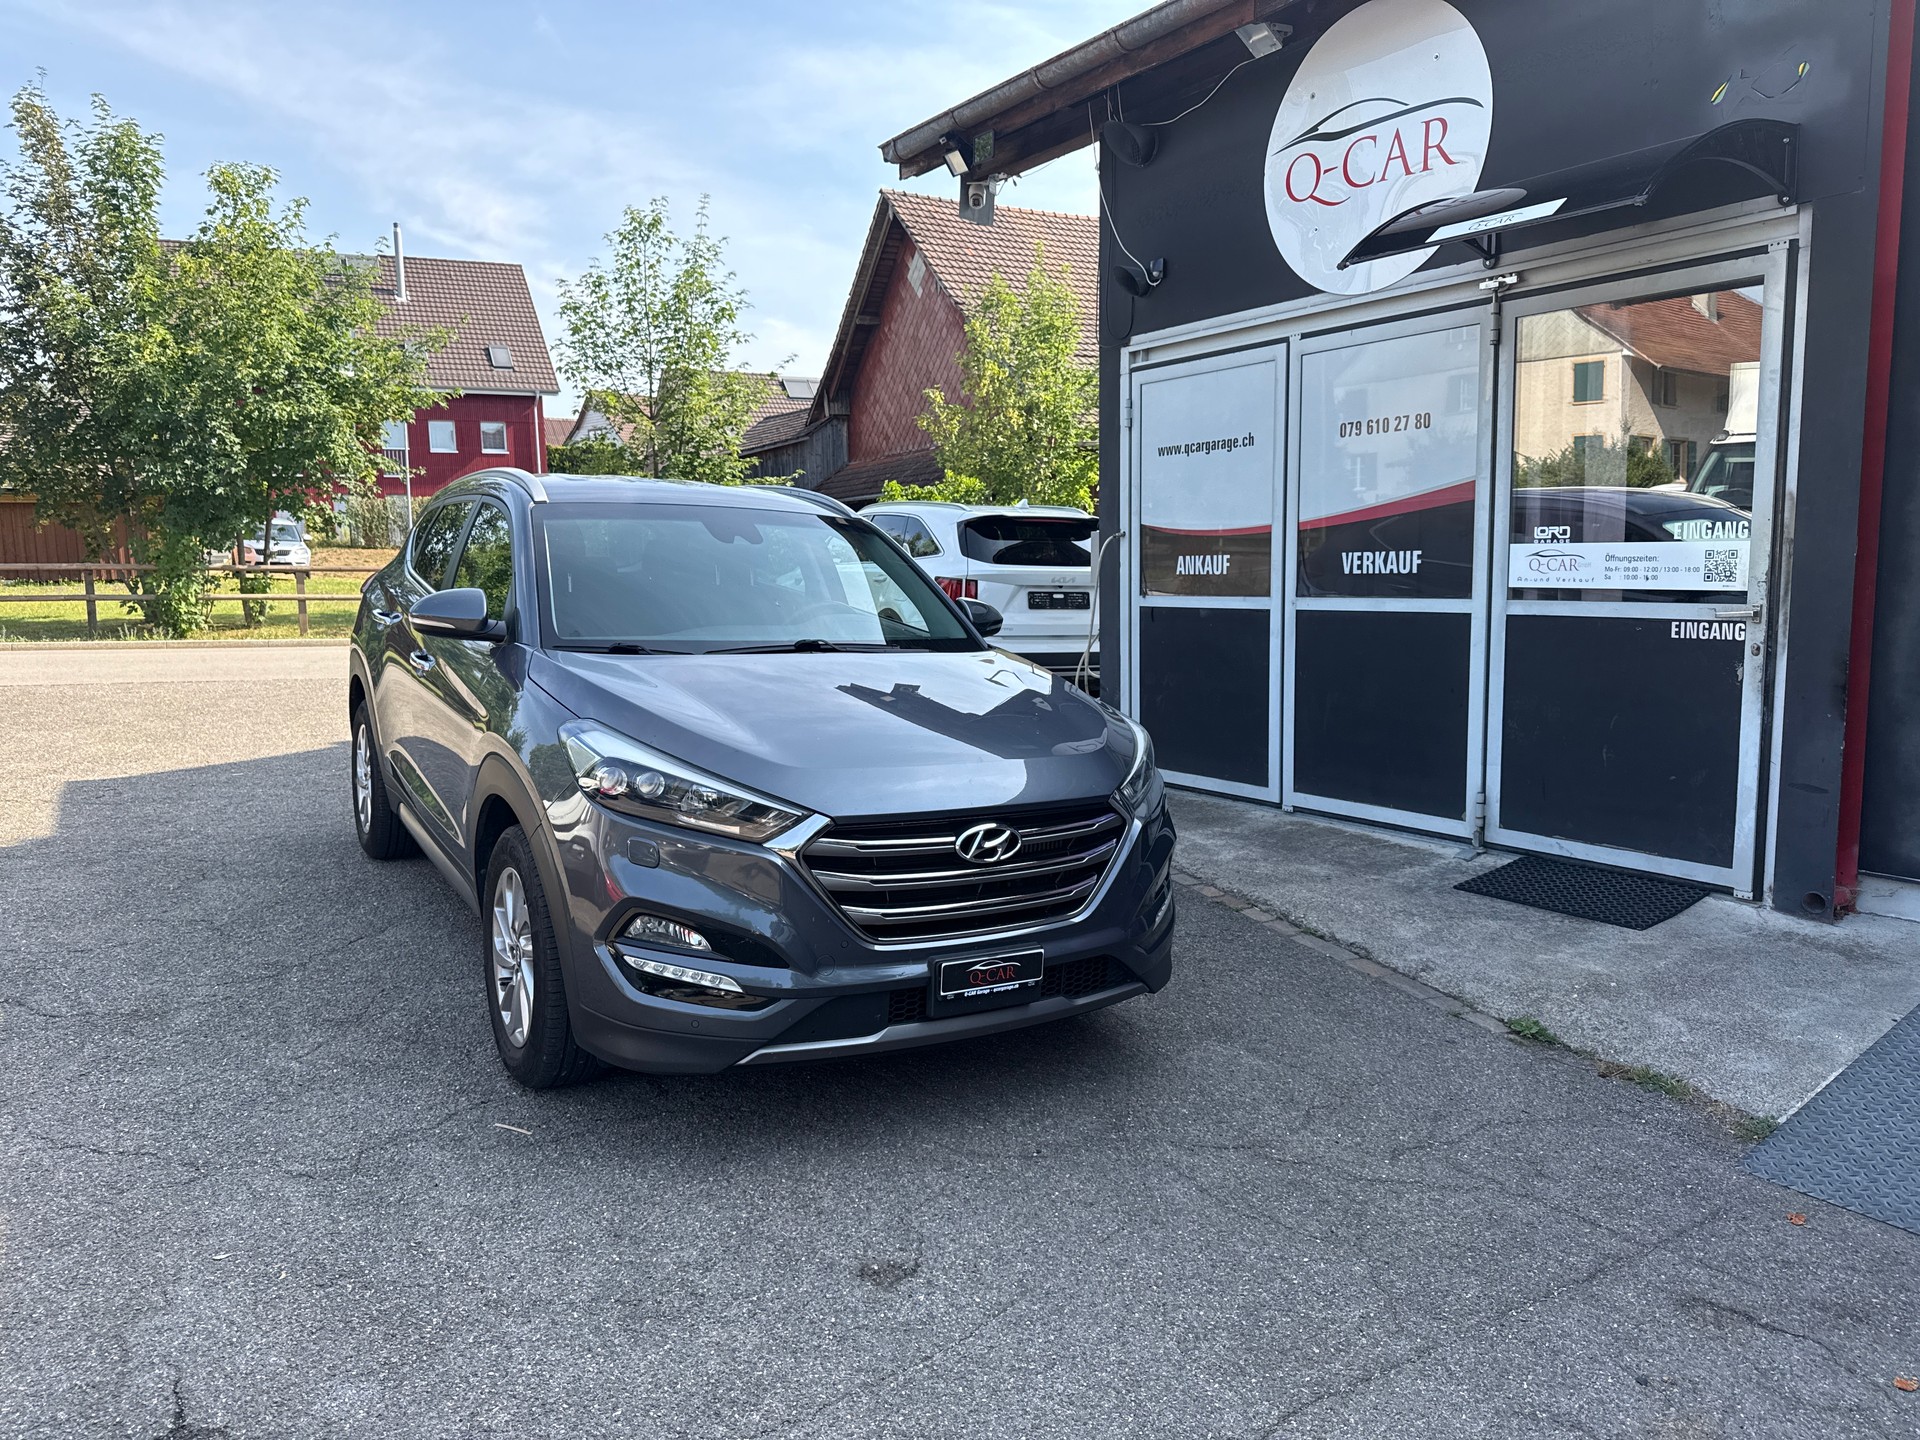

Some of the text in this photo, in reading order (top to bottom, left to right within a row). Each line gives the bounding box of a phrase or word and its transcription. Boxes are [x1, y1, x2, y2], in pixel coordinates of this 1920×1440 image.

[1285, 117, 1460, 206] Q-CAR
[1468, 215, 1515, 231] Q-CAR
[1340, 412, 1431, 438] 079 610 27 80
[1157, 432, 1255, 457] www.qcargarage.ch
[1534, 526, 1571, 538] LORD
[1673, 520, 1749, 540] EINGANG
[1176, 554, 1231, 576] ANKAUF
[1341, 550, 1422, 575] VERKAUF
[1529, 558, 1579, 574] Q-CAR
[1605, 553, 1659, 563] Öffnungszeiten:
[1671, 621, 1746, 641] EINGANG
[970, 966, 1015, 985] Q-CAR
